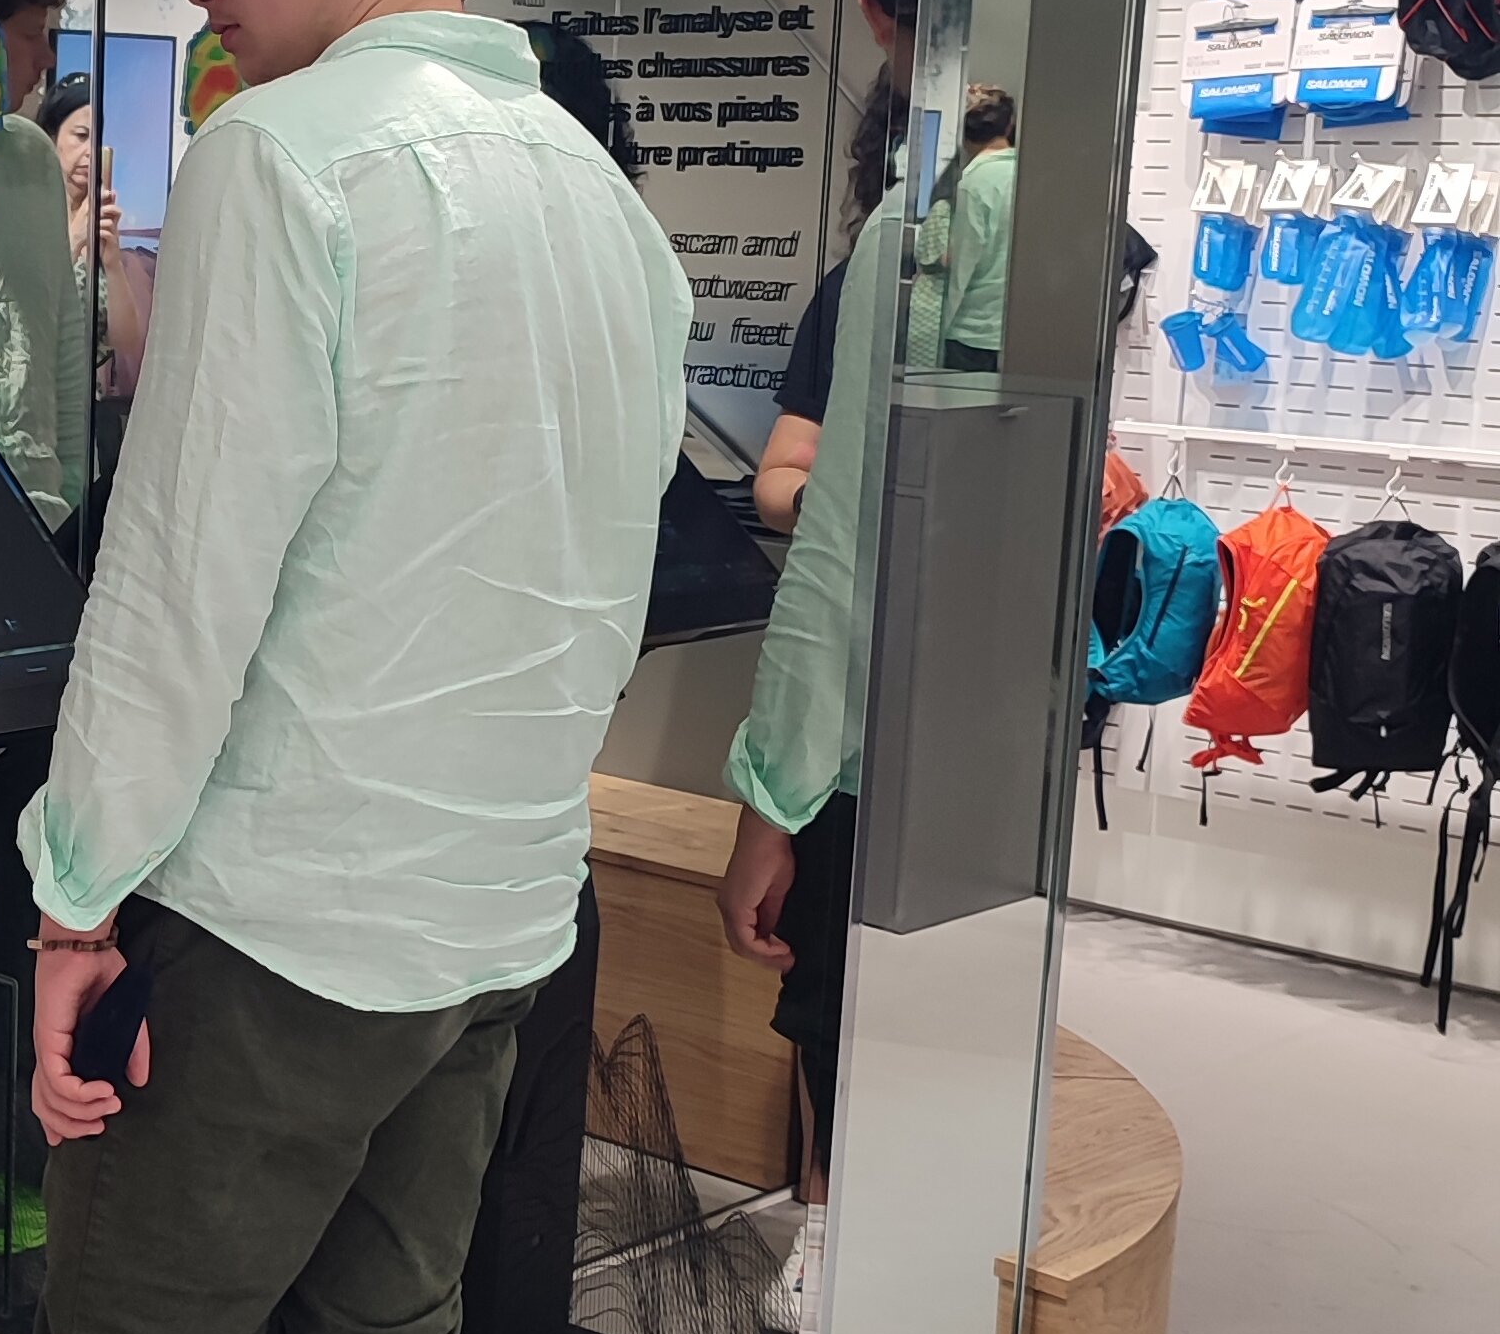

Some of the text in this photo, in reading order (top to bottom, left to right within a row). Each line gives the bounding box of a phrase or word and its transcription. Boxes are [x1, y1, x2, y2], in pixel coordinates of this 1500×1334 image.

[551, 3, 815, 38] Faites l'analyse et
[637, 51, 810, 79] chaussures
[1198, 81, 1262, 99] SALOMON
[1305, 76, 1369, 91] SALOMON
[637, 95, 655, 123] à
[660, 101, 713, 123] vos
[717, 94, 800, 127] pieds
[676, 140, 804, 173] pratique
[669, 230, 801, 257] scan and
[730, 317, 795, 346] feet
